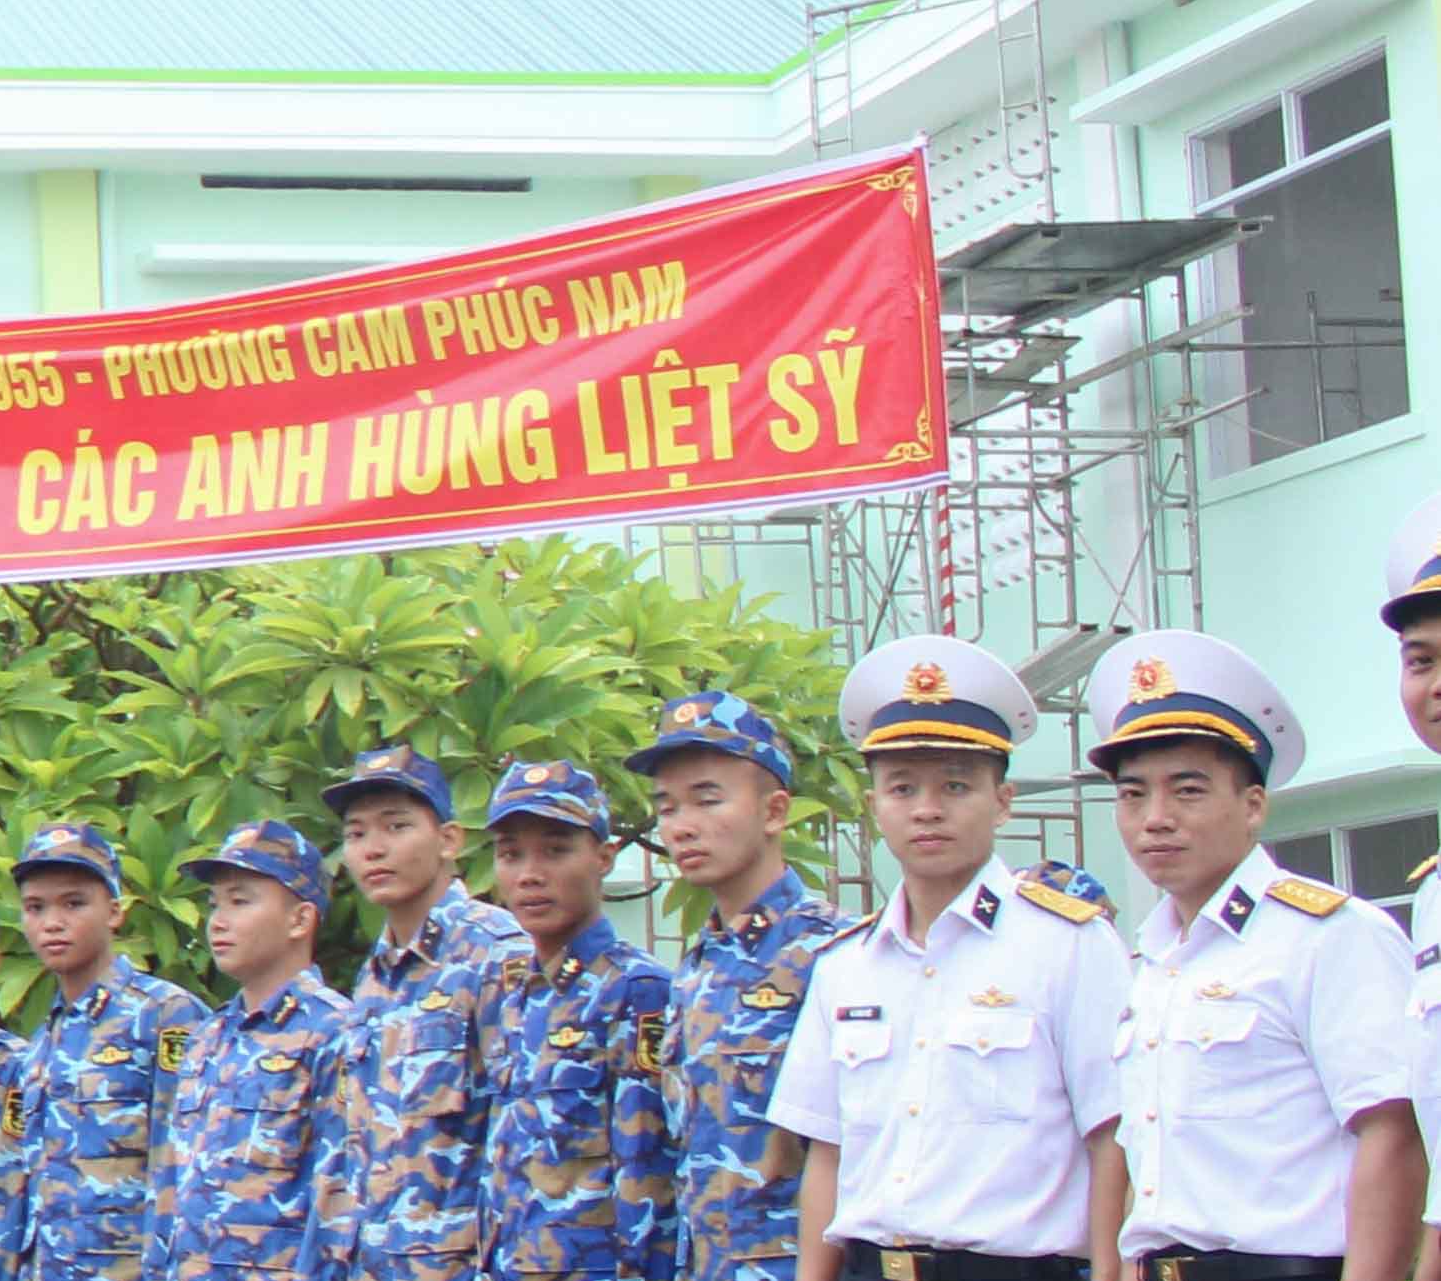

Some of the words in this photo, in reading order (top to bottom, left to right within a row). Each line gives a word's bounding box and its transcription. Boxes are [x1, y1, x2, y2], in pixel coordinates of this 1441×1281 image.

[103, 325, 296, 400] PHƯỜNG
[302, 305, 416, 376] CAM
[430, 276, 560, 362] PHÚC
[574, 260, 687, 341] NAM
[16, 428, 156, 536] CÁC
[178, 421, 330, 522] ANH
[349, 390, 557, 503] HÙNG
[578, 350, 740, 489] LIỆT
[767, 326, 866, 455] SỸ
